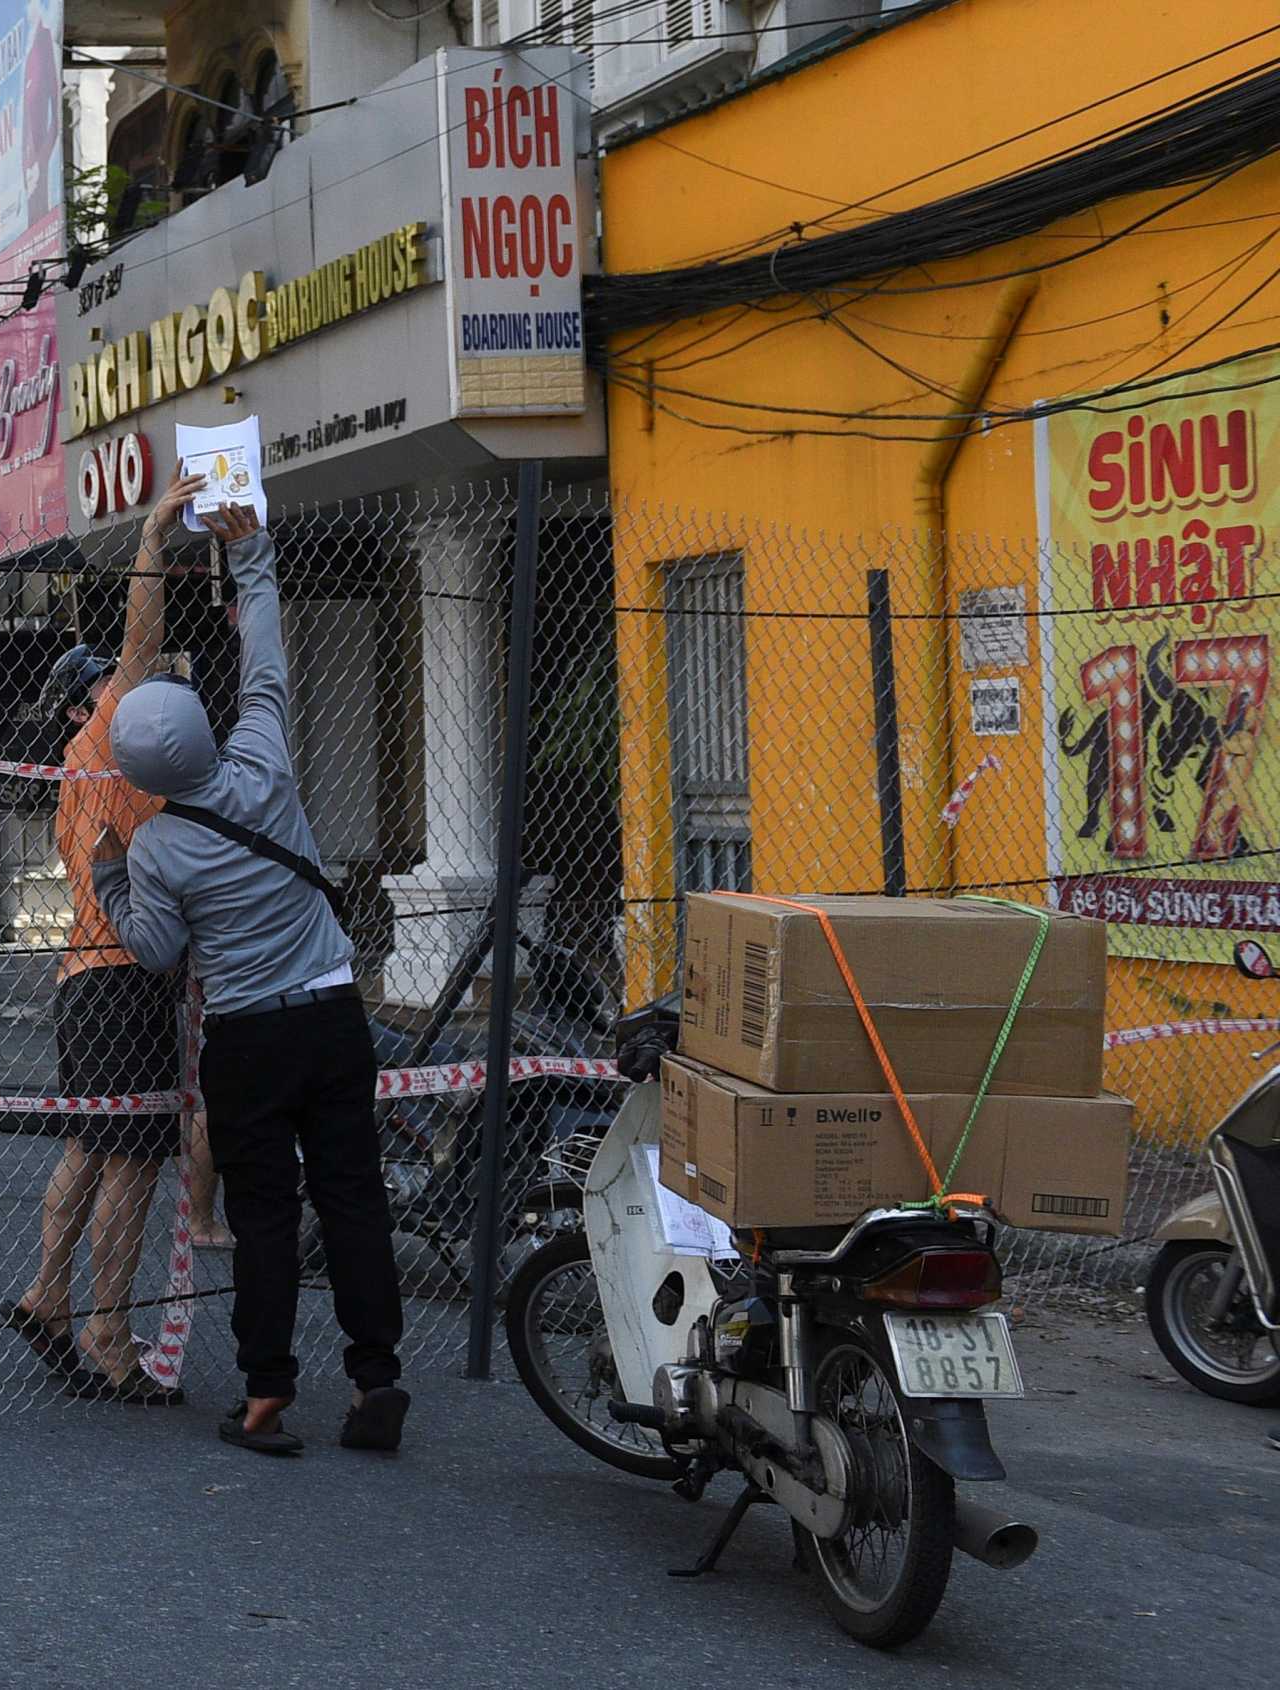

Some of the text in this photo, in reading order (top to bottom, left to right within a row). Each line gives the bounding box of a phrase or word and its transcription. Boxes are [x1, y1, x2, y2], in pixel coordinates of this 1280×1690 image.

[464, 68, 561, 169] BÍCH
[461, 193, 573, 297] NGỌC
[150, 270, 267, 404] NGỌC
[265, 254, 354, 350] BOARDING
[356, 222, 427, 311] HOUSE
[461, 311, 581, 351] BOARDING HOUSE
[77, 432, 149, 519] OYO
[816, 1108, 867, 1123] B.Well
[916, 1356, 1001, 1391] 8857
